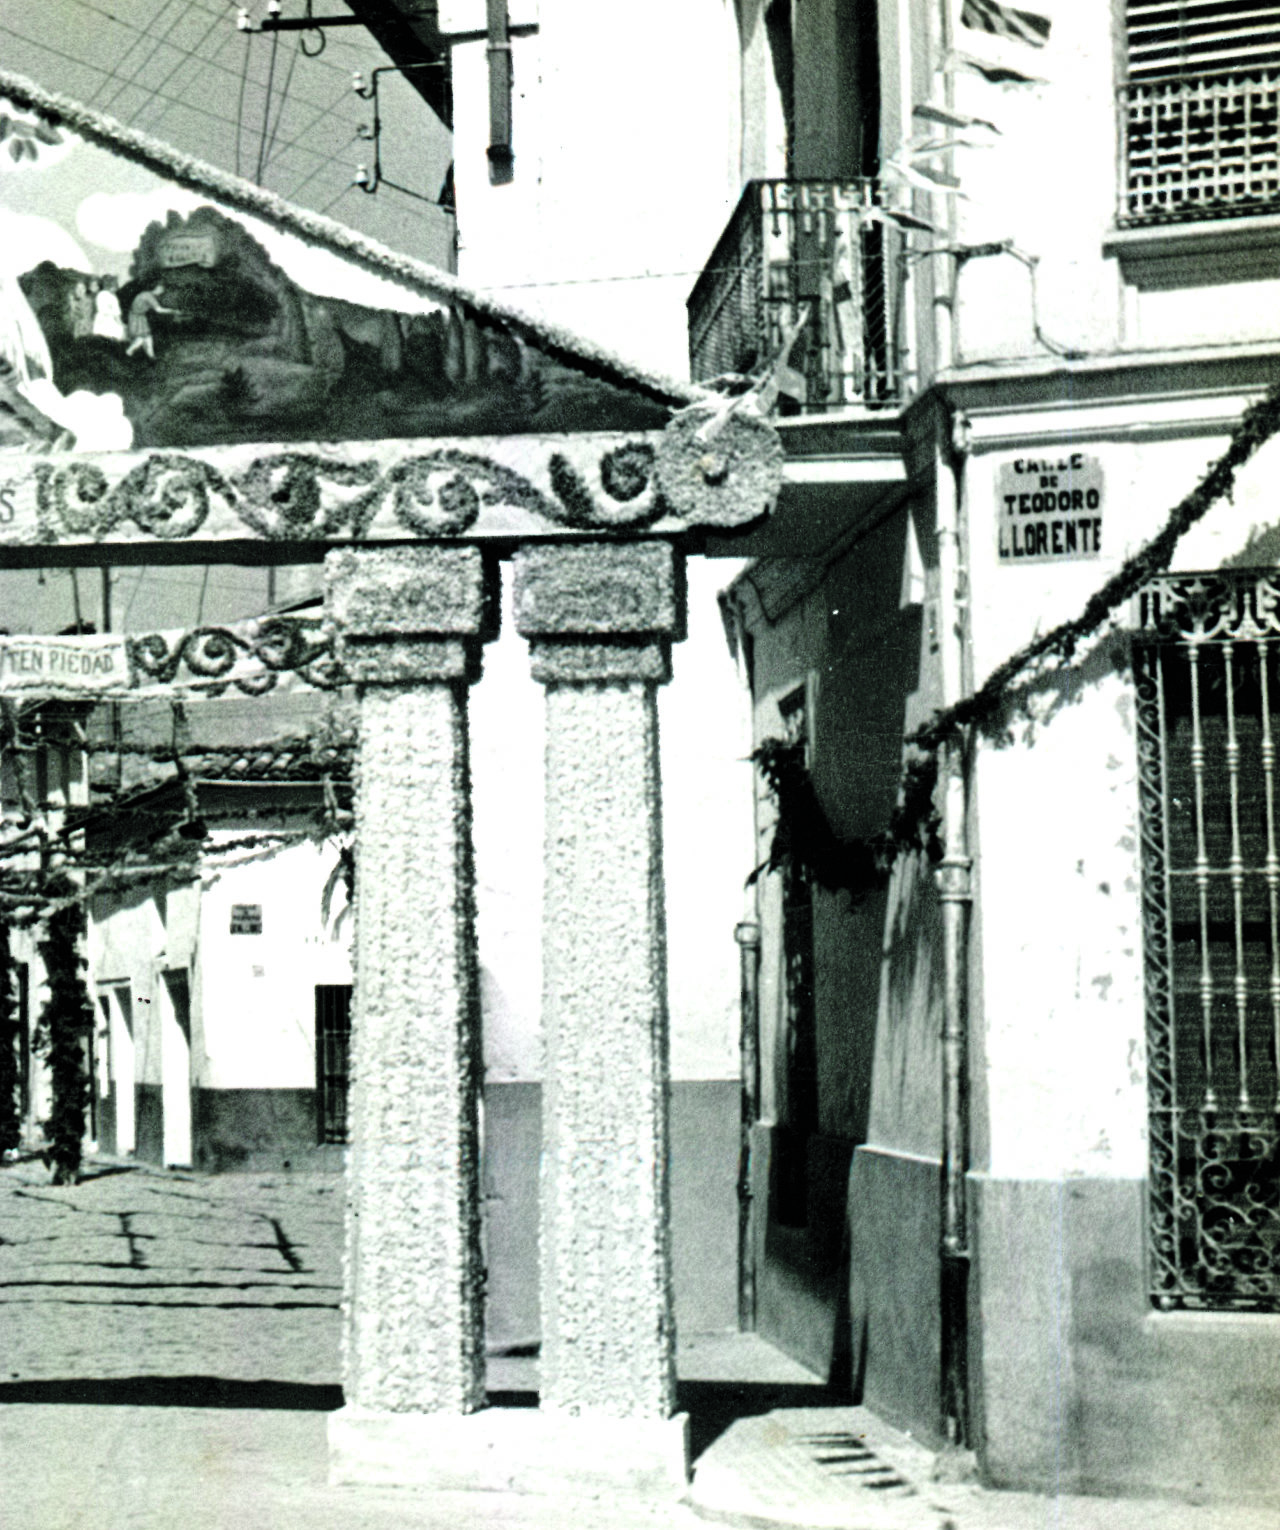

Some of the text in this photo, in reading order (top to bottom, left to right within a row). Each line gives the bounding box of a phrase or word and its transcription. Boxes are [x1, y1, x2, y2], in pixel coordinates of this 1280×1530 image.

[1040, 475, 1058, 488] DE
[1004, 488, 1099, 515] TEODORO
[999, 518, 1102, 558] LLORENTE
[9, 648, 43, 672] TEN
[50, 651, 114, 674] PIEDAD
